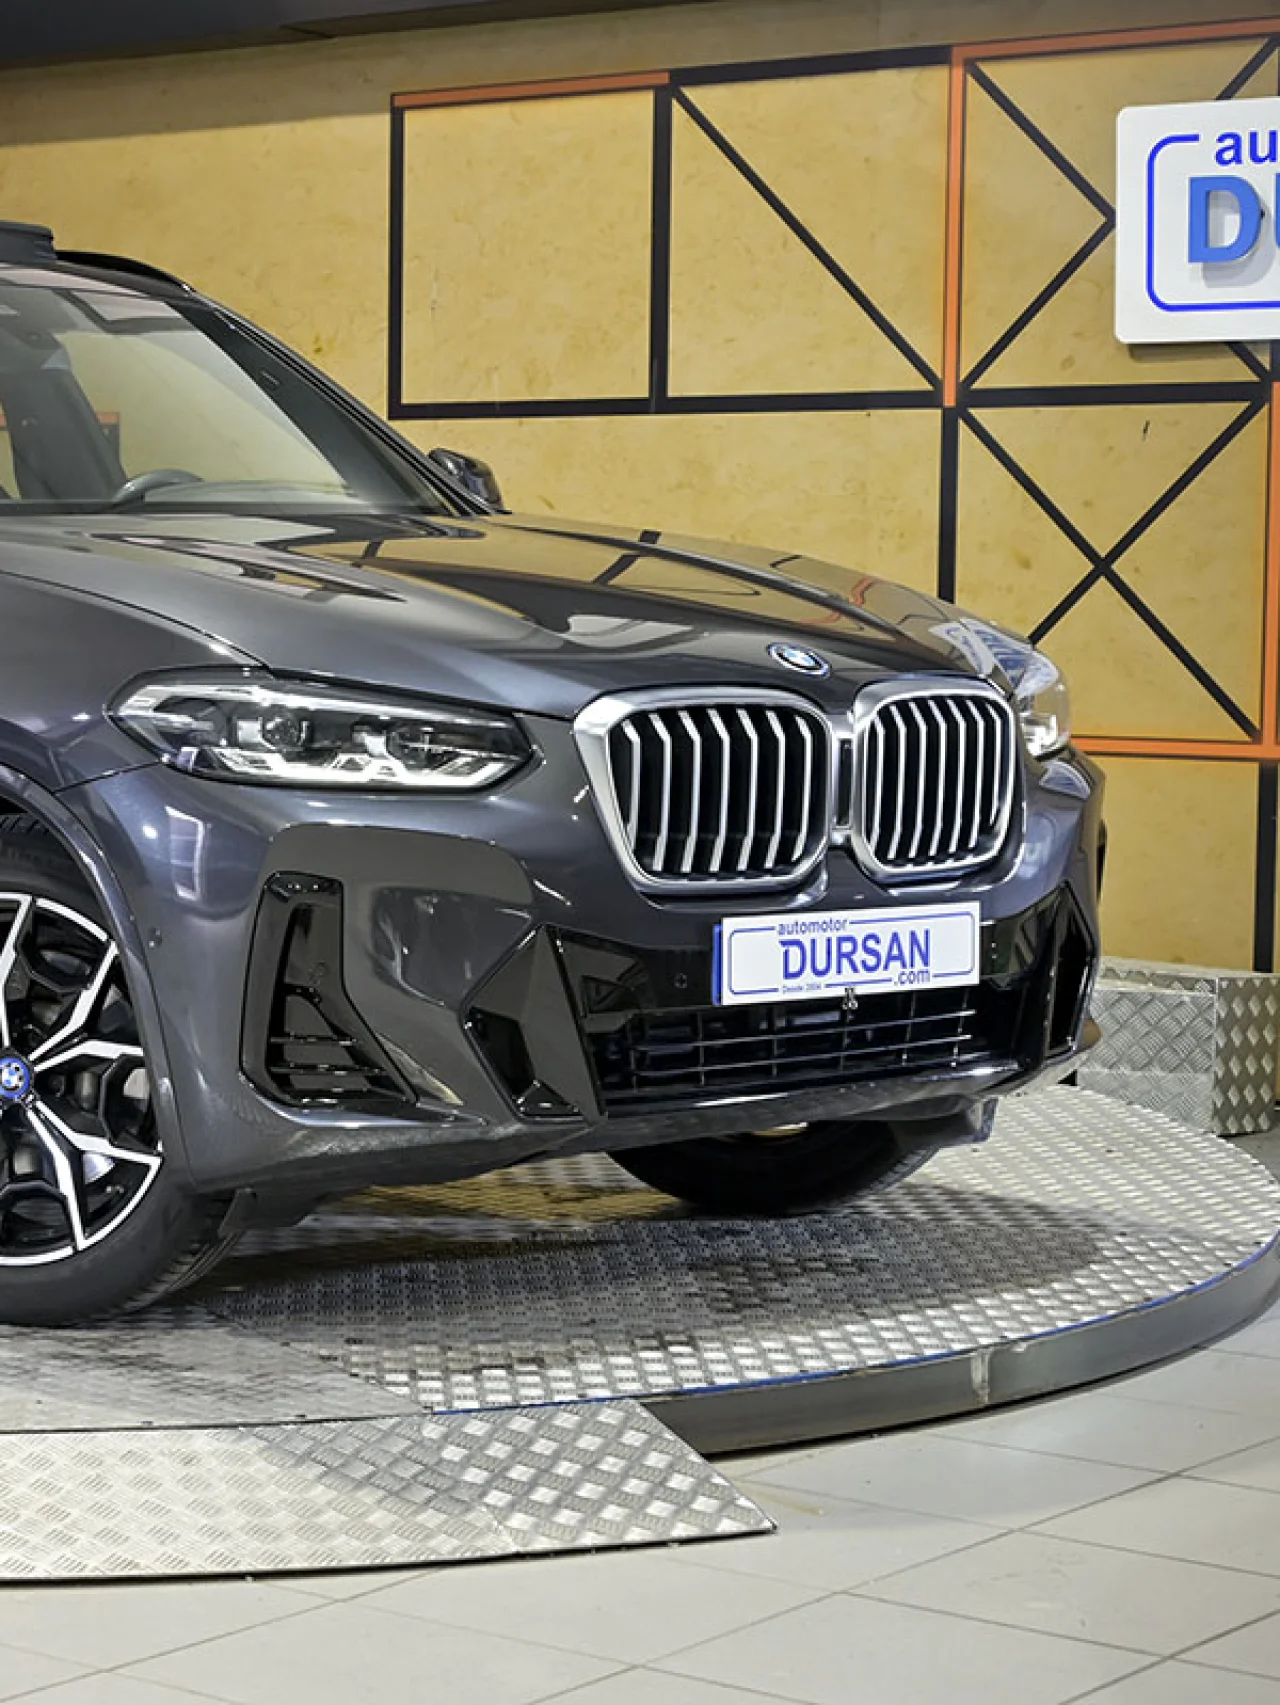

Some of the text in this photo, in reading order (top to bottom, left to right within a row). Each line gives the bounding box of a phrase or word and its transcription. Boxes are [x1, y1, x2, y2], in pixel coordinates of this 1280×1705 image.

[1214, 129, 1278, 166] au
[1187, 172, 1280, 263] D
[777, 918, 848, 936] automotor
[778, 929, 931, 980] DURSAN
[894, 969, 931, 986] .com
